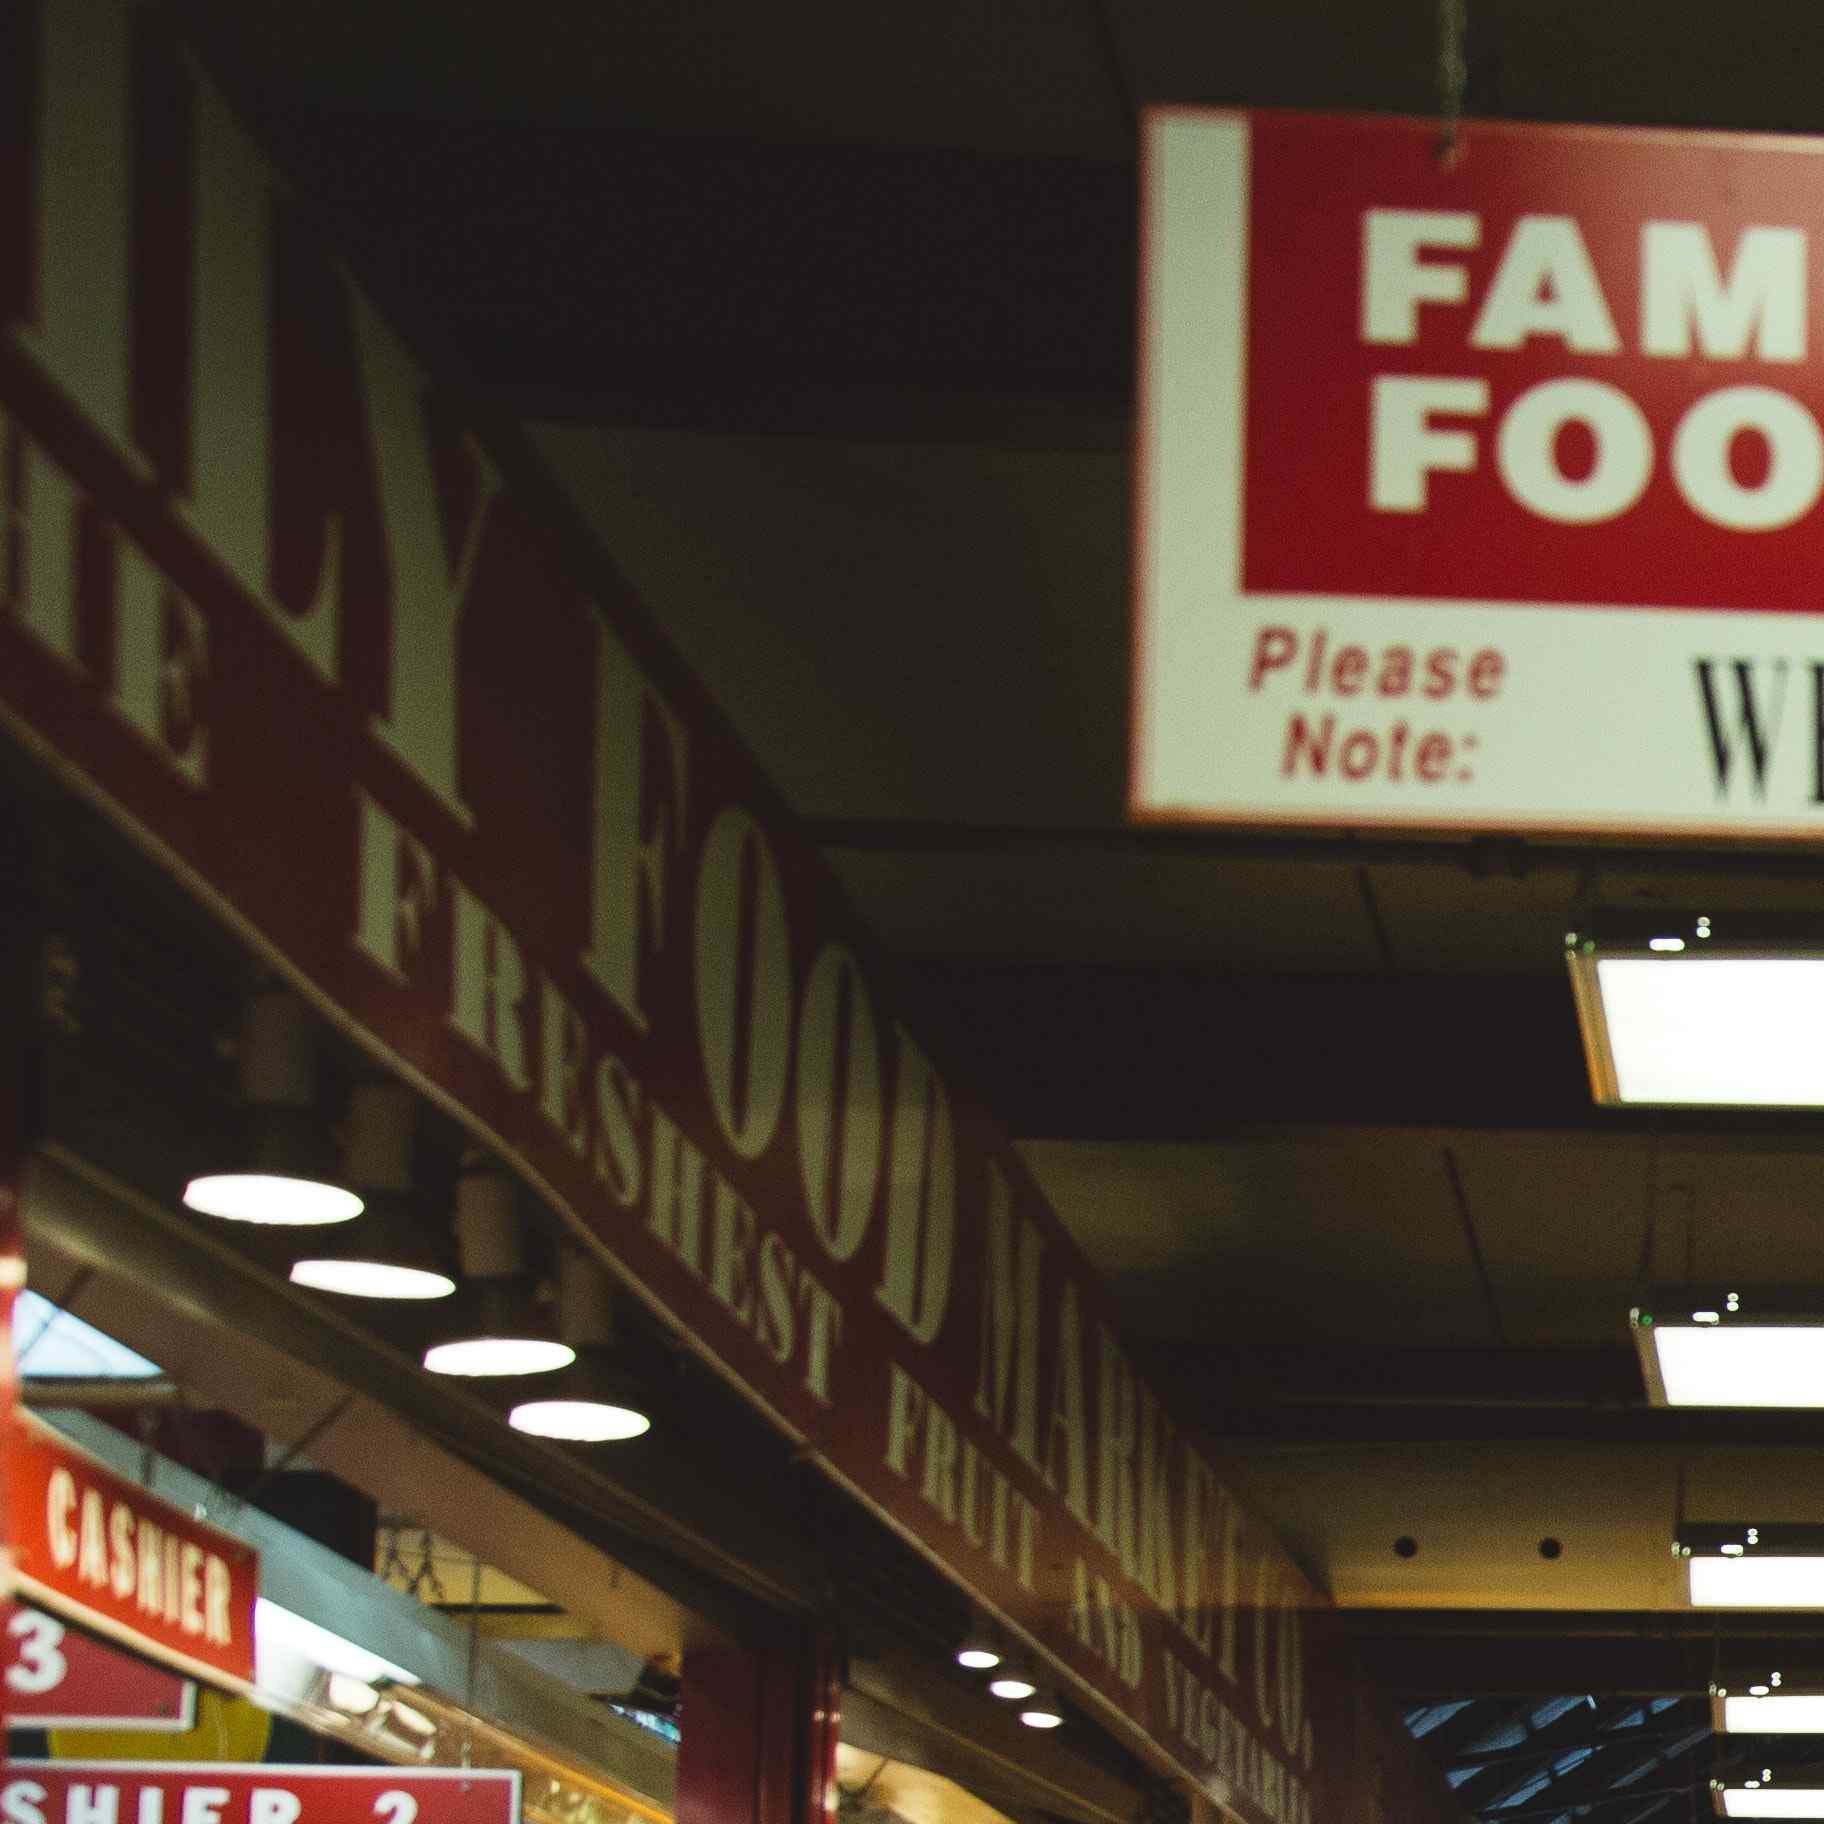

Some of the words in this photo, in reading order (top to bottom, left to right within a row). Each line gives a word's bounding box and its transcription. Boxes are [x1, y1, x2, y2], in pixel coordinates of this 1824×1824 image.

[1246, 624, 1509, 701] Please
[1280, 709, 1481, 786] Note:
[354, 781, 843, 1402] FRESHEST
[885, 1357, 1040, 1595] FRUIT
[580, 598, 957, 1346] FOOD
[972, 1154, 1244, 1686] MARKET
[46, 1466, 233, 1648] CASHIER
[4, 1608, 67, 1695] 3
